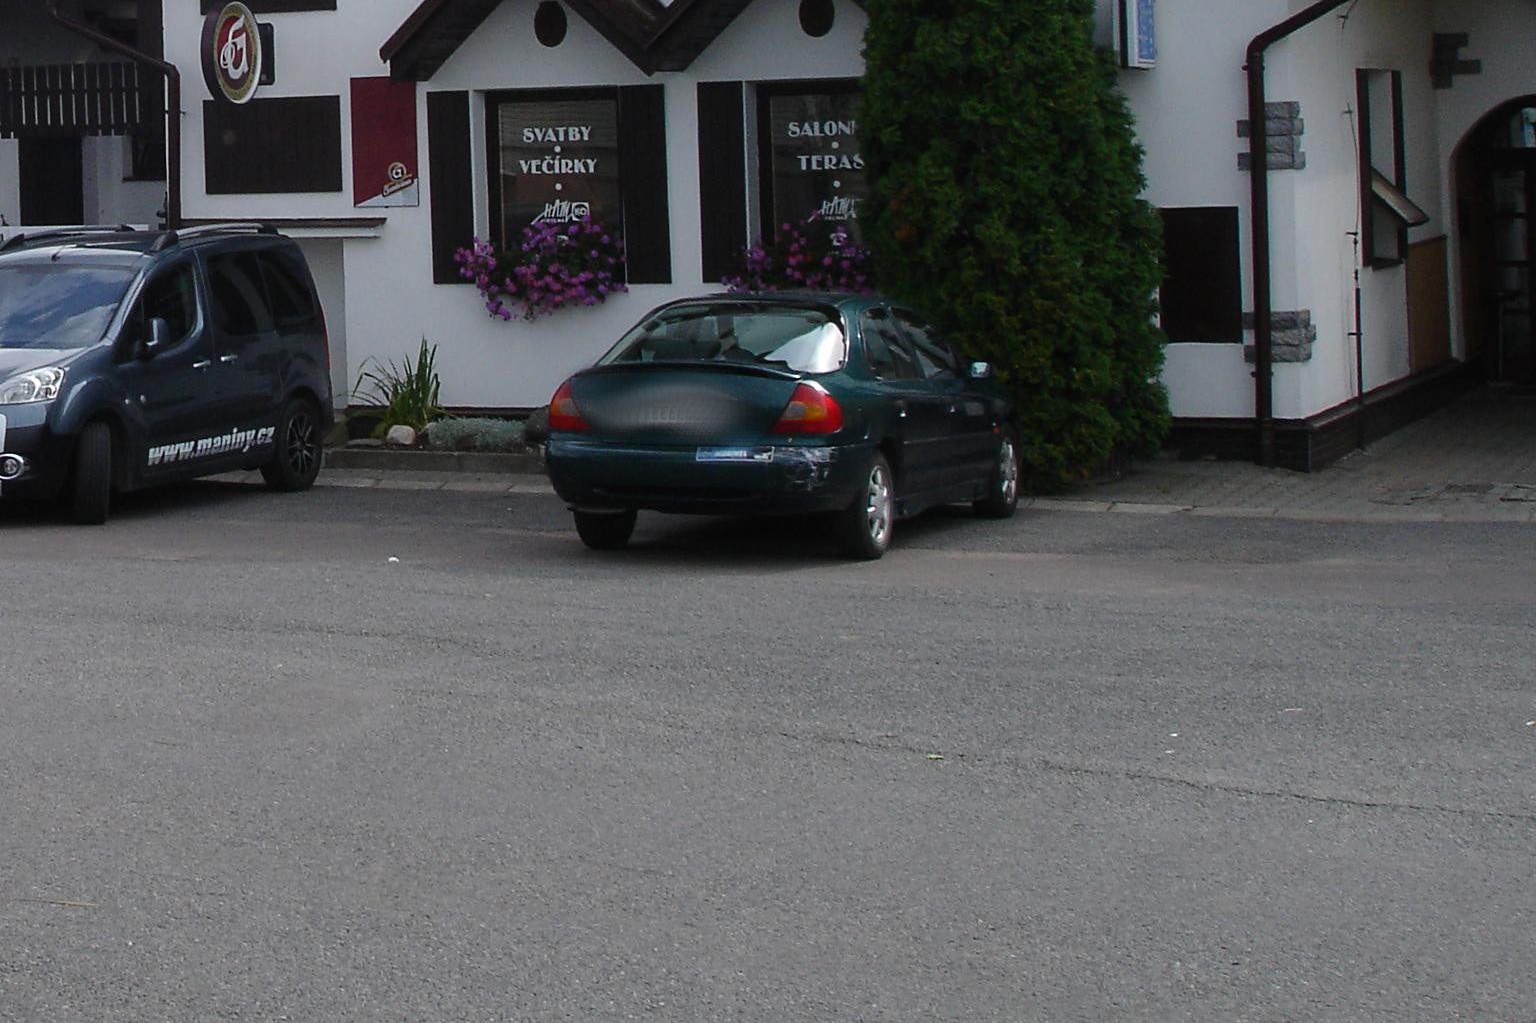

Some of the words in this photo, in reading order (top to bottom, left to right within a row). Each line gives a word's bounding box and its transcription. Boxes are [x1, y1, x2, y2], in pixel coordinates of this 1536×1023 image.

[523, 126, 591, 143] SVATBY
[519, 155, 597, 174] VEČÍRKY
[147, 426, 275, 466] www.maniny.cz
